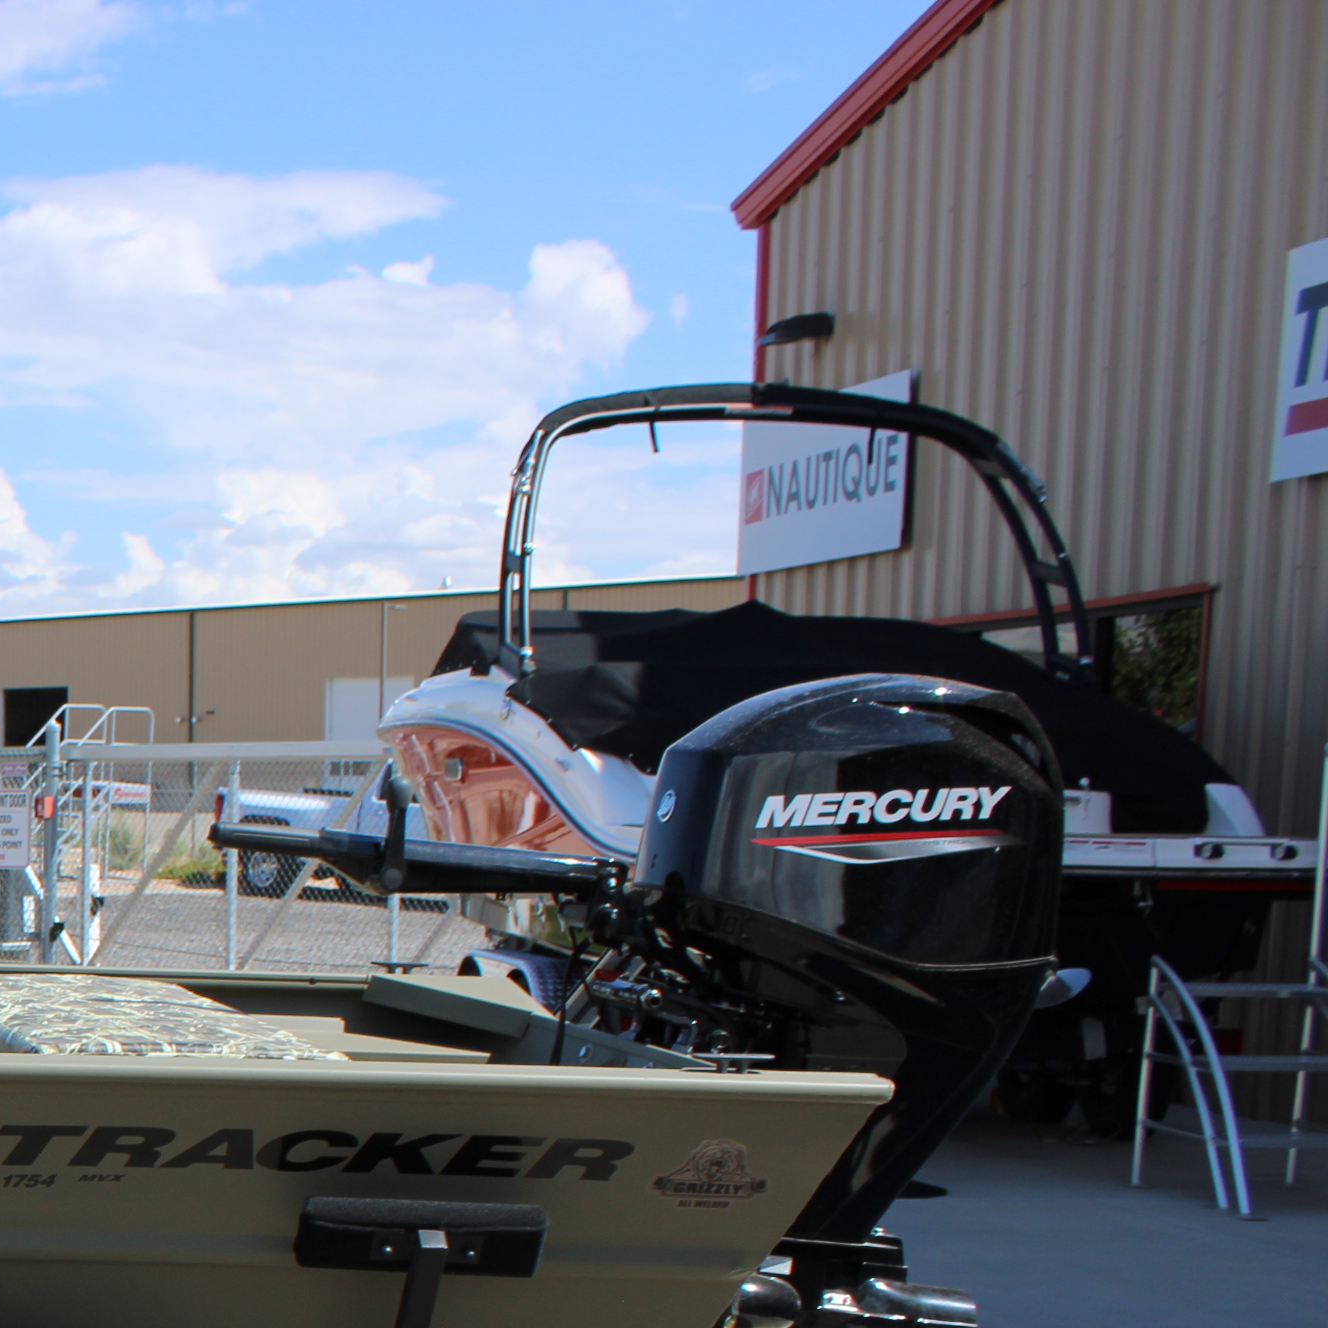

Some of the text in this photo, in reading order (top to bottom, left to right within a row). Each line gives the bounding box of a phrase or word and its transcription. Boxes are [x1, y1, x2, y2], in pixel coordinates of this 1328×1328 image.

[764, 433, 899, 519] NAUTIQUE
[9, 793, 26, 808] DOOR
[755, 785, 1013, 829] MERCURY
[1, 827, 19, 836] ONLY
[2, 841, 23, 849] POINT
[1, 1173, 125, 1188] 1754 MVX
[673, 1181, 744, 1195] GRIZZLY
